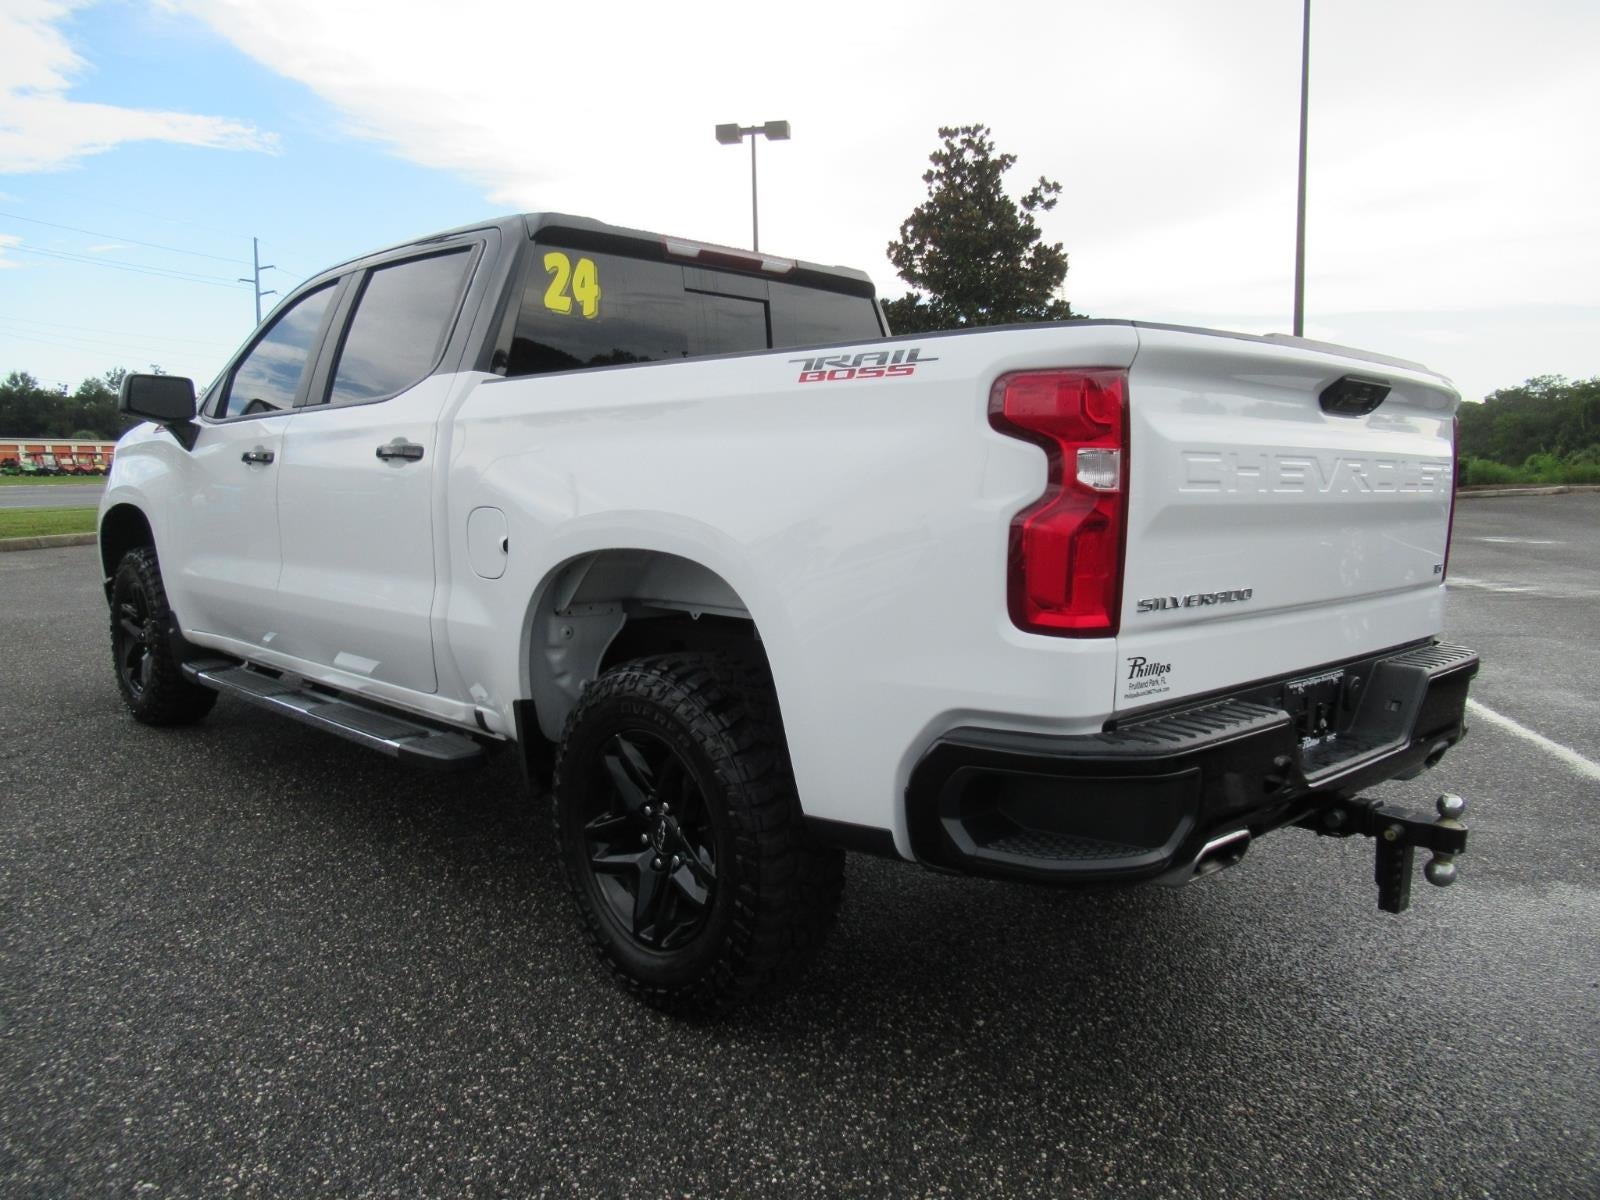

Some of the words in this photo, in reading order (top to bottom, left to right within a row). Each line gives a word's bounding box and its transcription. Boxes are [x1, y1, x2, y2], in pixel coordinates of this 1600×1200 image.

[544, 252, 601, 319] 24
[789, 348, 939, 371] TRAIL
[798, 364, 916, 382] BOSS
[1136, 588, 1253, 613] SILVERADO
[1127, 656, 1171, 679] Phillips
